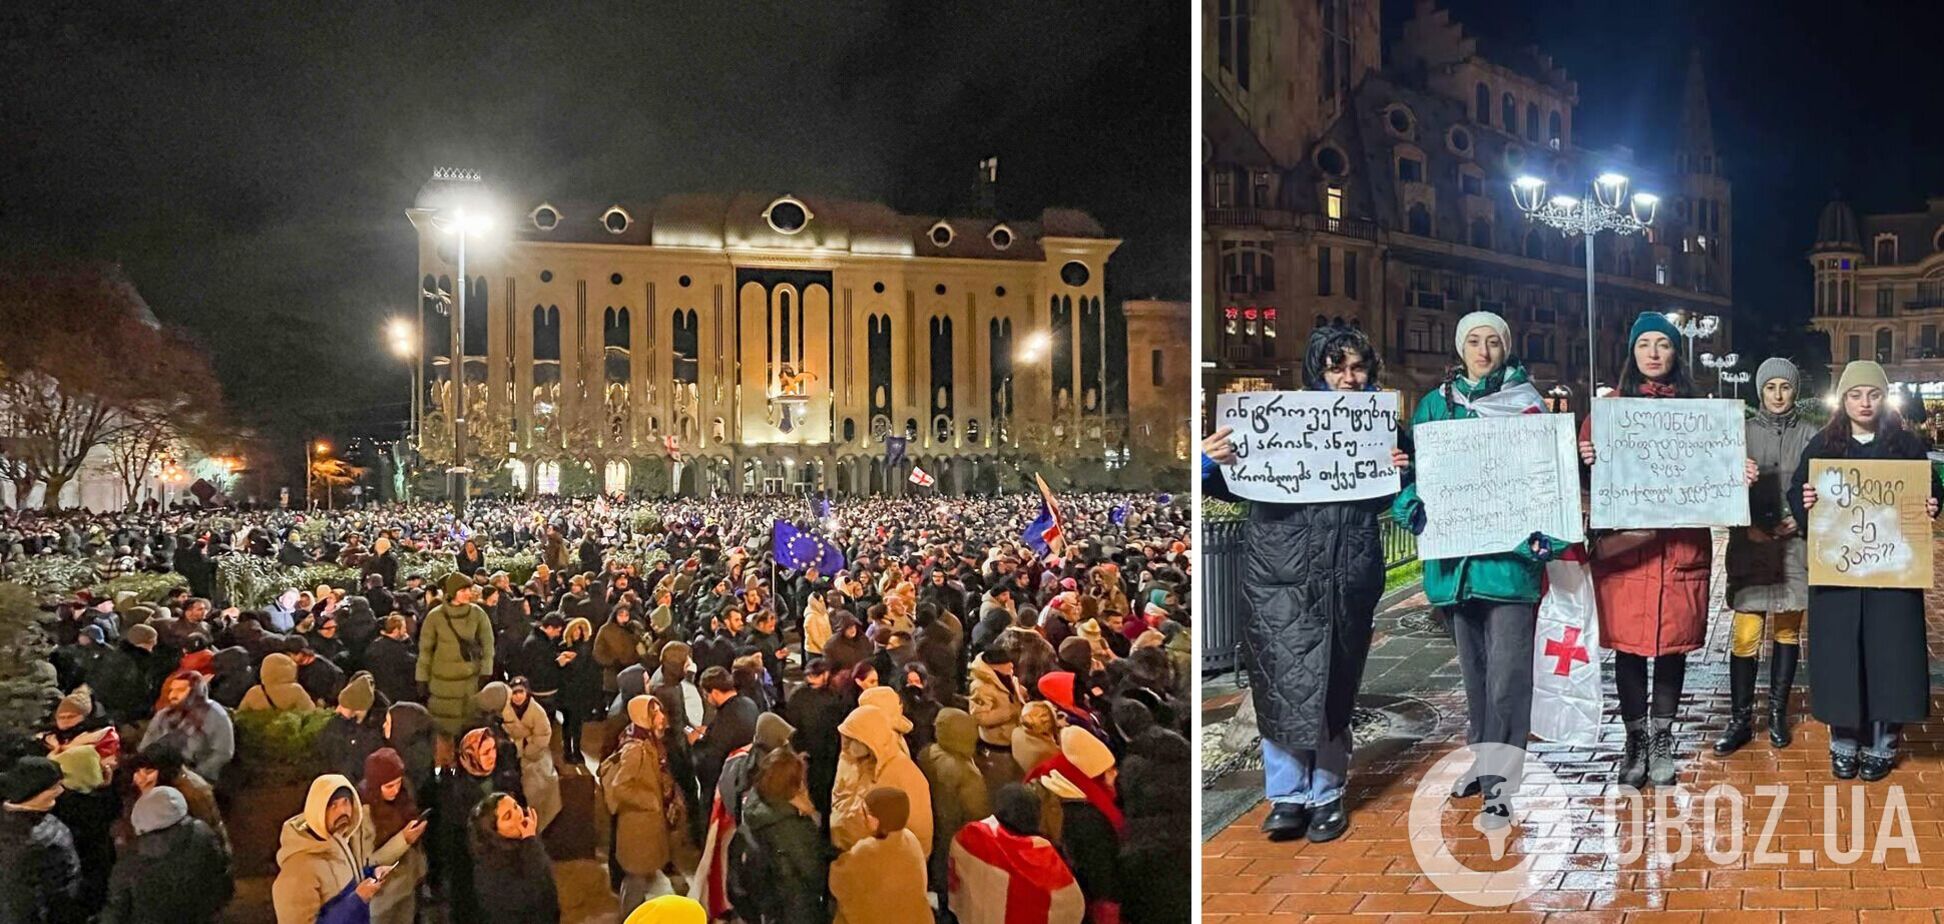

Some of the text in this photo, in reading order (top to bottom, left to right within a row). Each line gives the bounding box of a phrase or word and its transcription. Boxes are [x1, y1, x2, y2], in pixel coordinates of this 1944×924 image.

[1618, 410, 1713, 433] კლიენტის
[1257, 432, 1318, 451] არიან,
[1650, 462, 1687, 478] დაცვა
[1826, 466, 1905, 508] შემდეგი
[1851, 505, 1877, 543] მე
[1836, 543, 1895, 572] ვარ??
